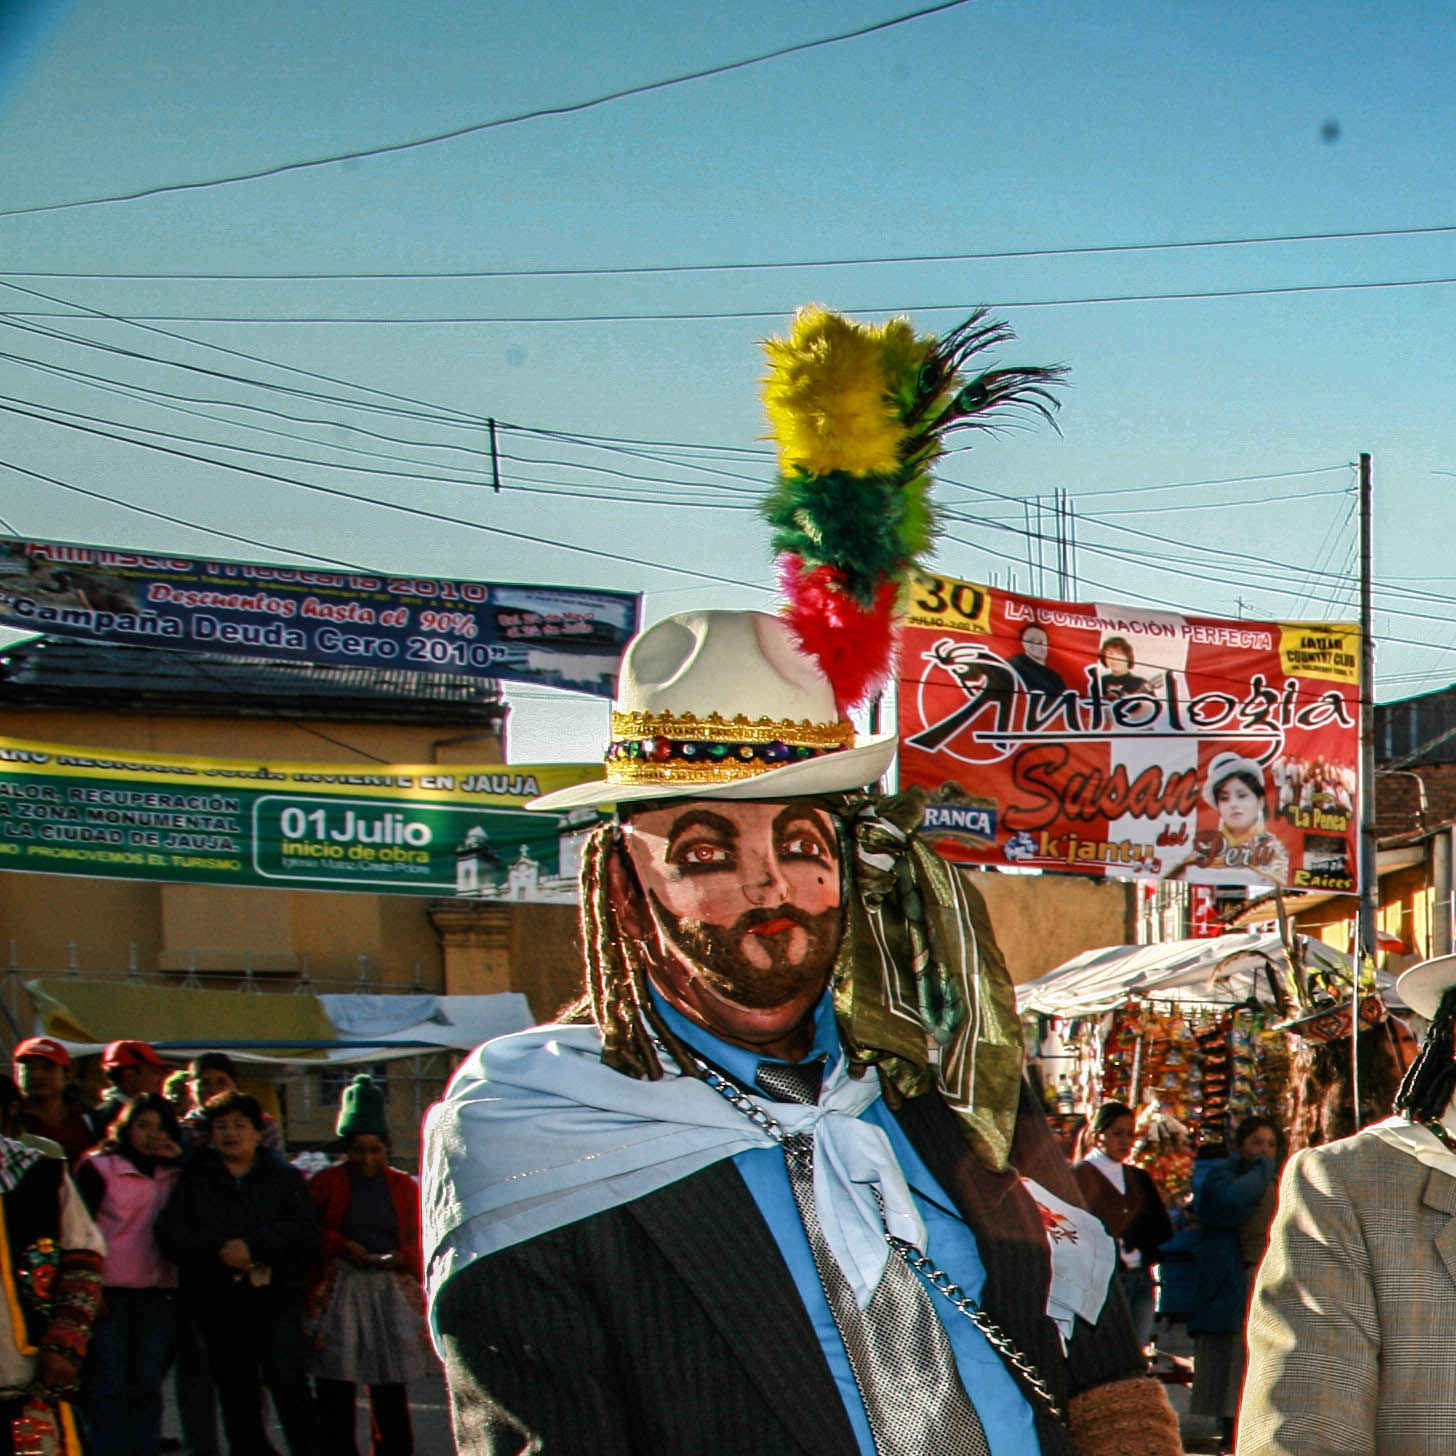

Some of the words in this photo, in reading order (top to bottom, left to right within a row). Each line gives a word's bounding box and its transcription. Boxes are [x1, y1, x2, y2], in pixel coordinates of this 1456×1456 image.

[148, 582, 298, 618] Descuentos
[301, 596, 376, 625] hasta
[379, 606, 409, 628] el
[419, 610, 479, 639] 90%
[191, 613, 307, 650] Deuda
[315, 626, 398, 658] Cero
[1004, 600, 1035, 622] LA
[1181, 624, 1273, 650] PERFECTA
[420, 774, 455, 790] EN
[460, 775, 541, 796] JAUJA
[1002, 742, 1199, 832] Susan
[69, 786, 240, 813] RECUPERACIÓN
[16, 804, 80, 820] ZONA
[86, 808, 240, 832] MONUMENTAL
[923, 807, 991, 835] RANCA
[4, 821, 33, 838] LA
[39, 825, 123, 844] CIUDAD
[129, 831, 159, 847] DE
[282, 840, 344, 858] inicio
[348, 845, 376, 861] de
[378, 848, 430, 864] obra
